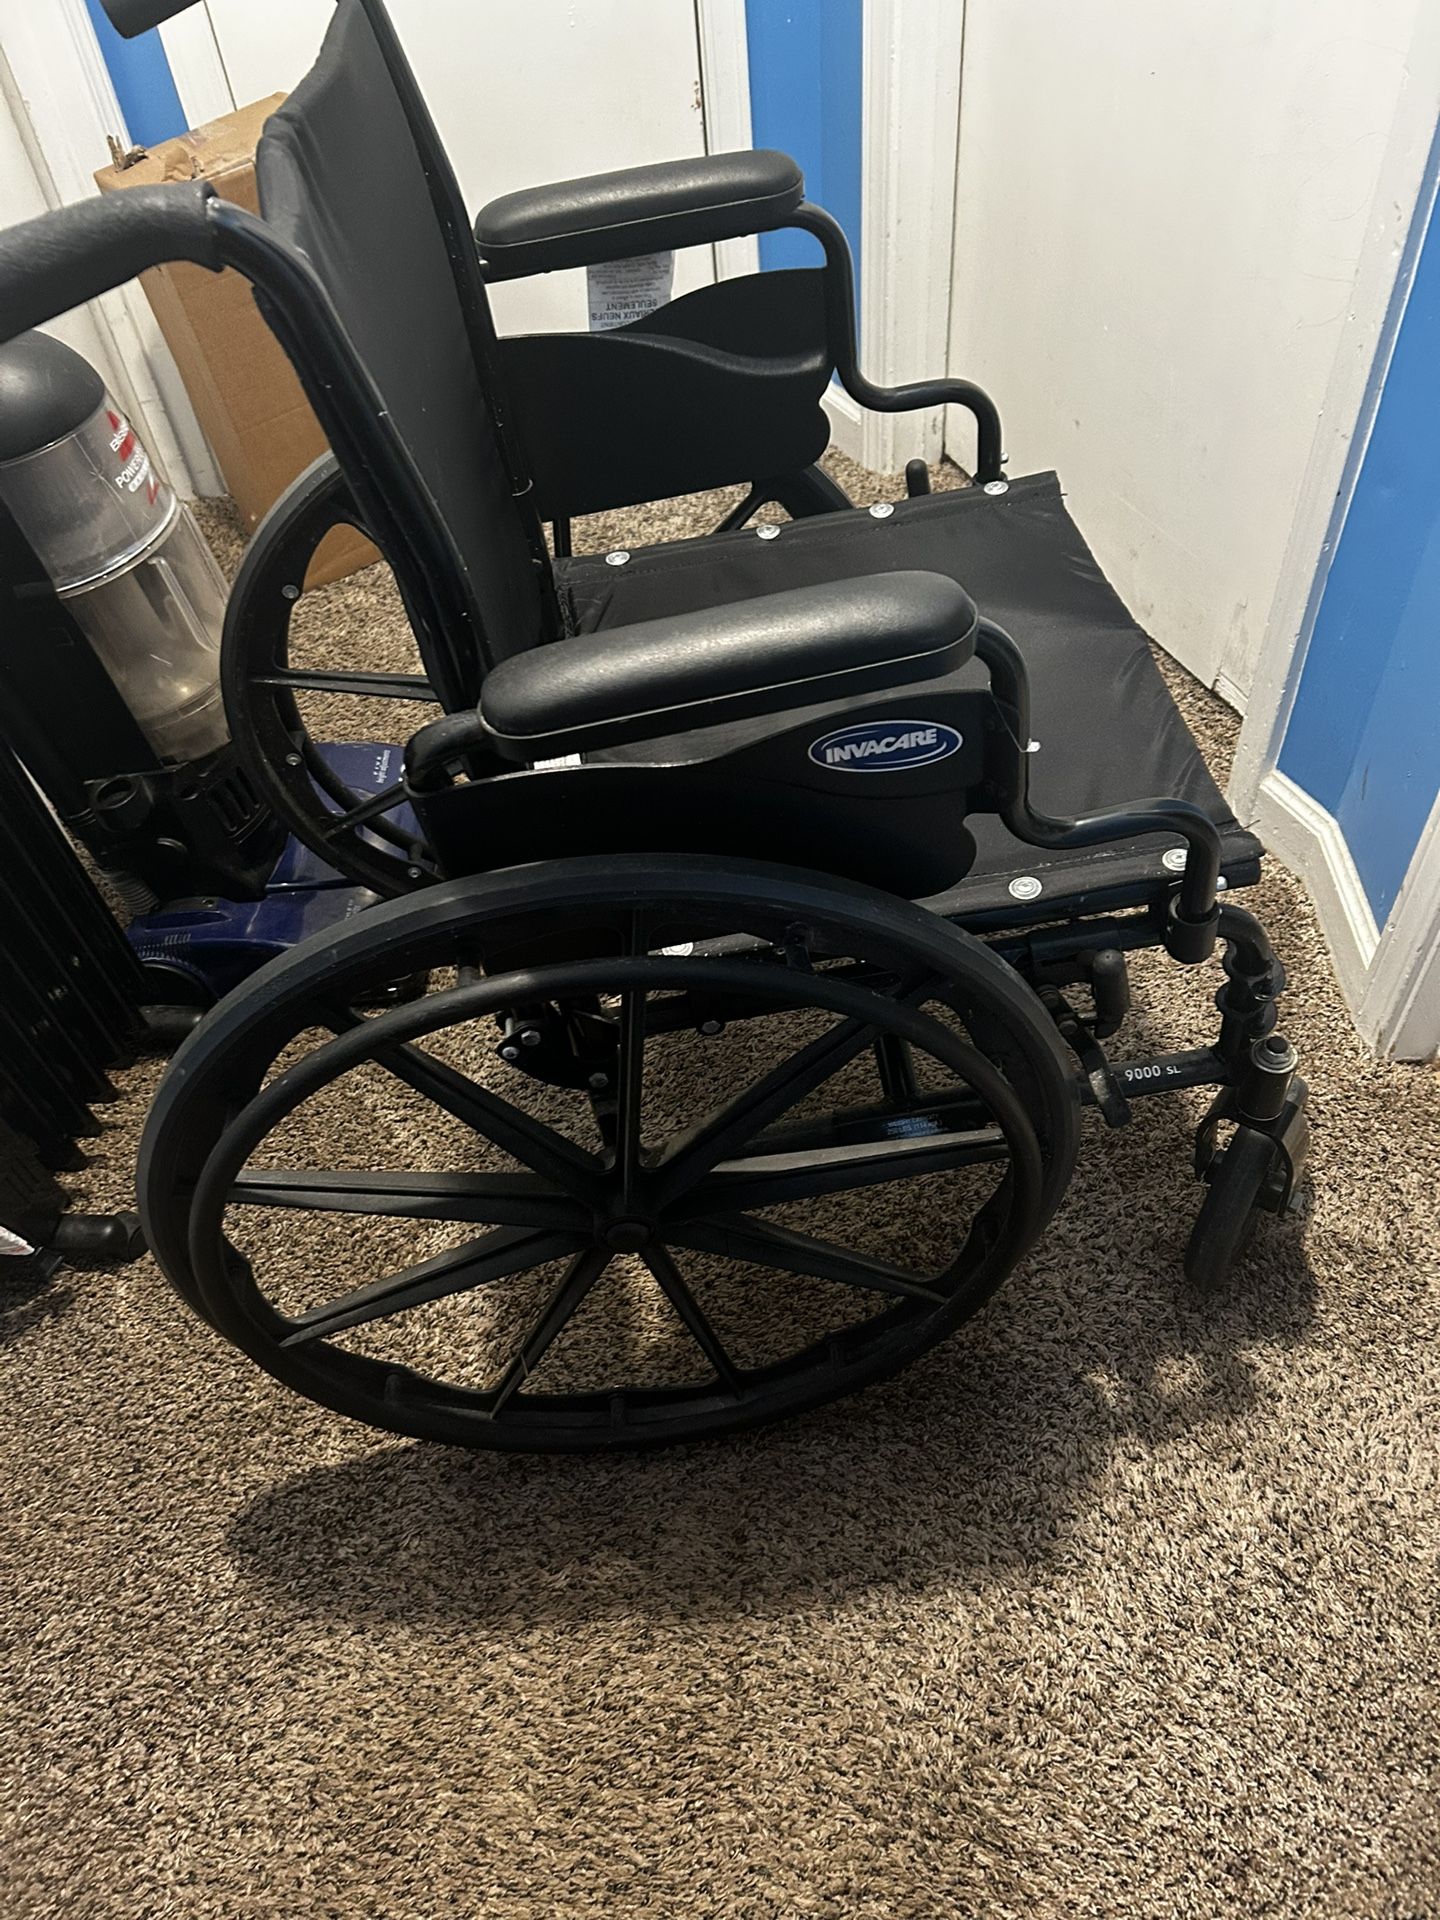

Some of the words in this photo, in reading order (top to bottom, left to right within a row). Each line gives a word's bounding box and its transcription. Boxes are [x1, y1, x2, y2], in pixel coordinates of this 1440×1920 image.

[606, 299, 657, 311] SEULEMENT
[592, 312, 621, 321] NEUFS
[825, 728, 937, 764] INVACARE
[1124, 1065, 1161, 1082] 9000
[1166, 1065, 1182, 1075] SL
